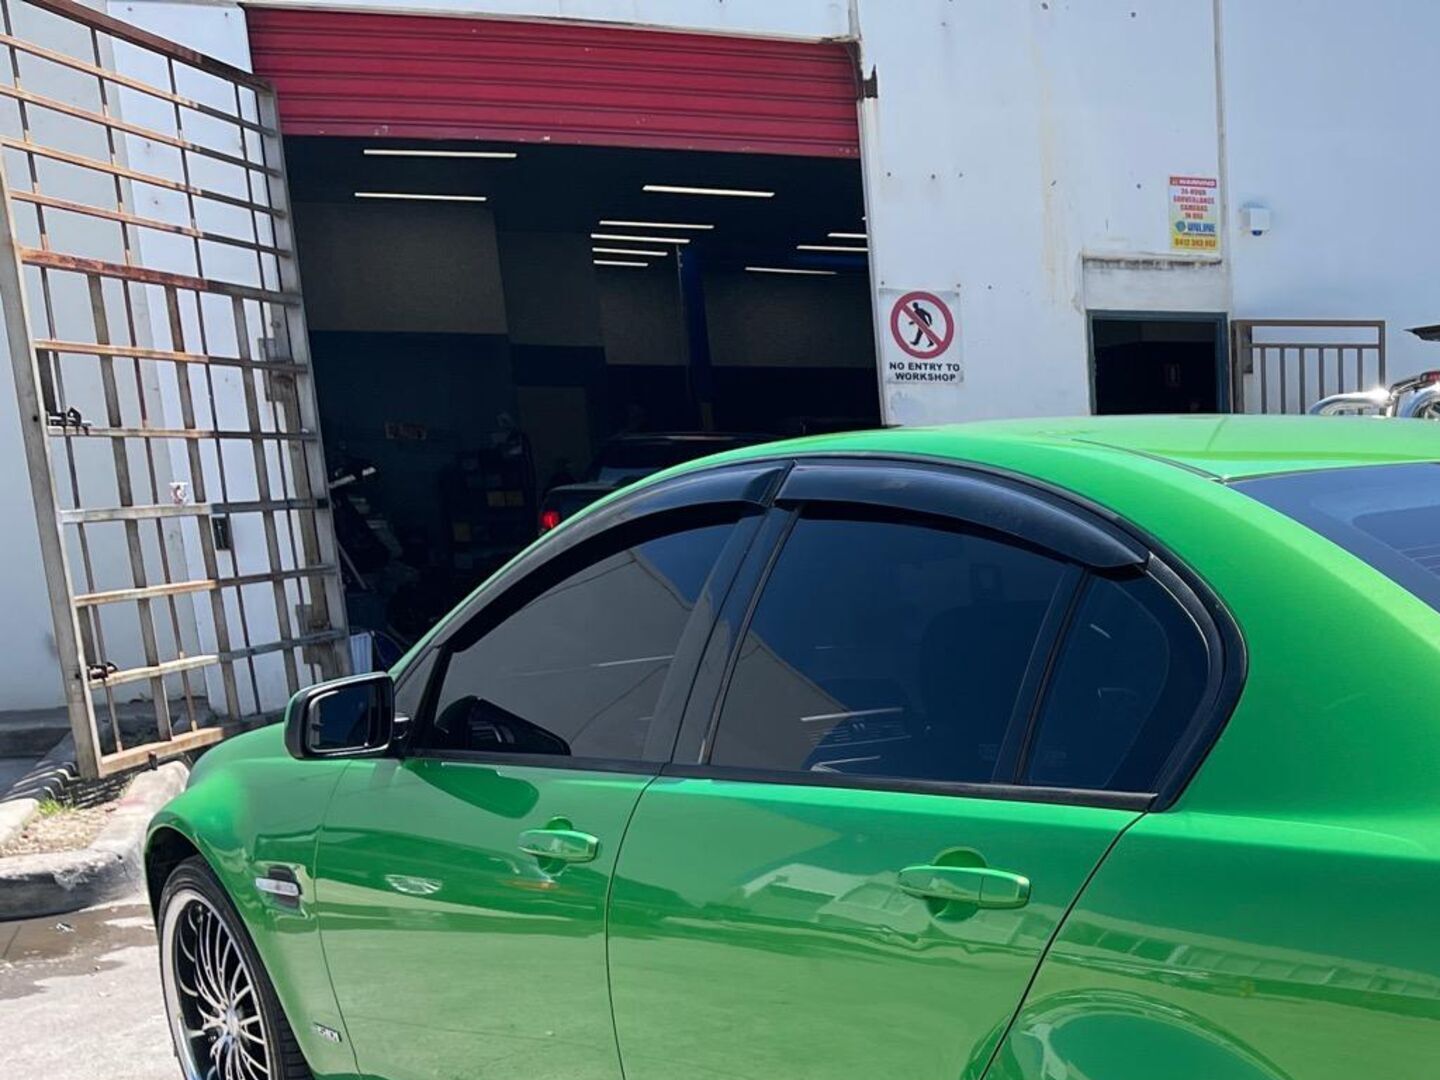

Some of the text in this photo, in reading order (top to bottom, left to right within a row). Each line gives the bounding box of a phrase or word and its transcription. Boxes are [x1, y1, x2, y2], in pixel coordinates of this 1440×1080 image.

[889, 362, 960, 372] NO ENTRY TO
[895, 372, 956, 381] WORKSHOP
